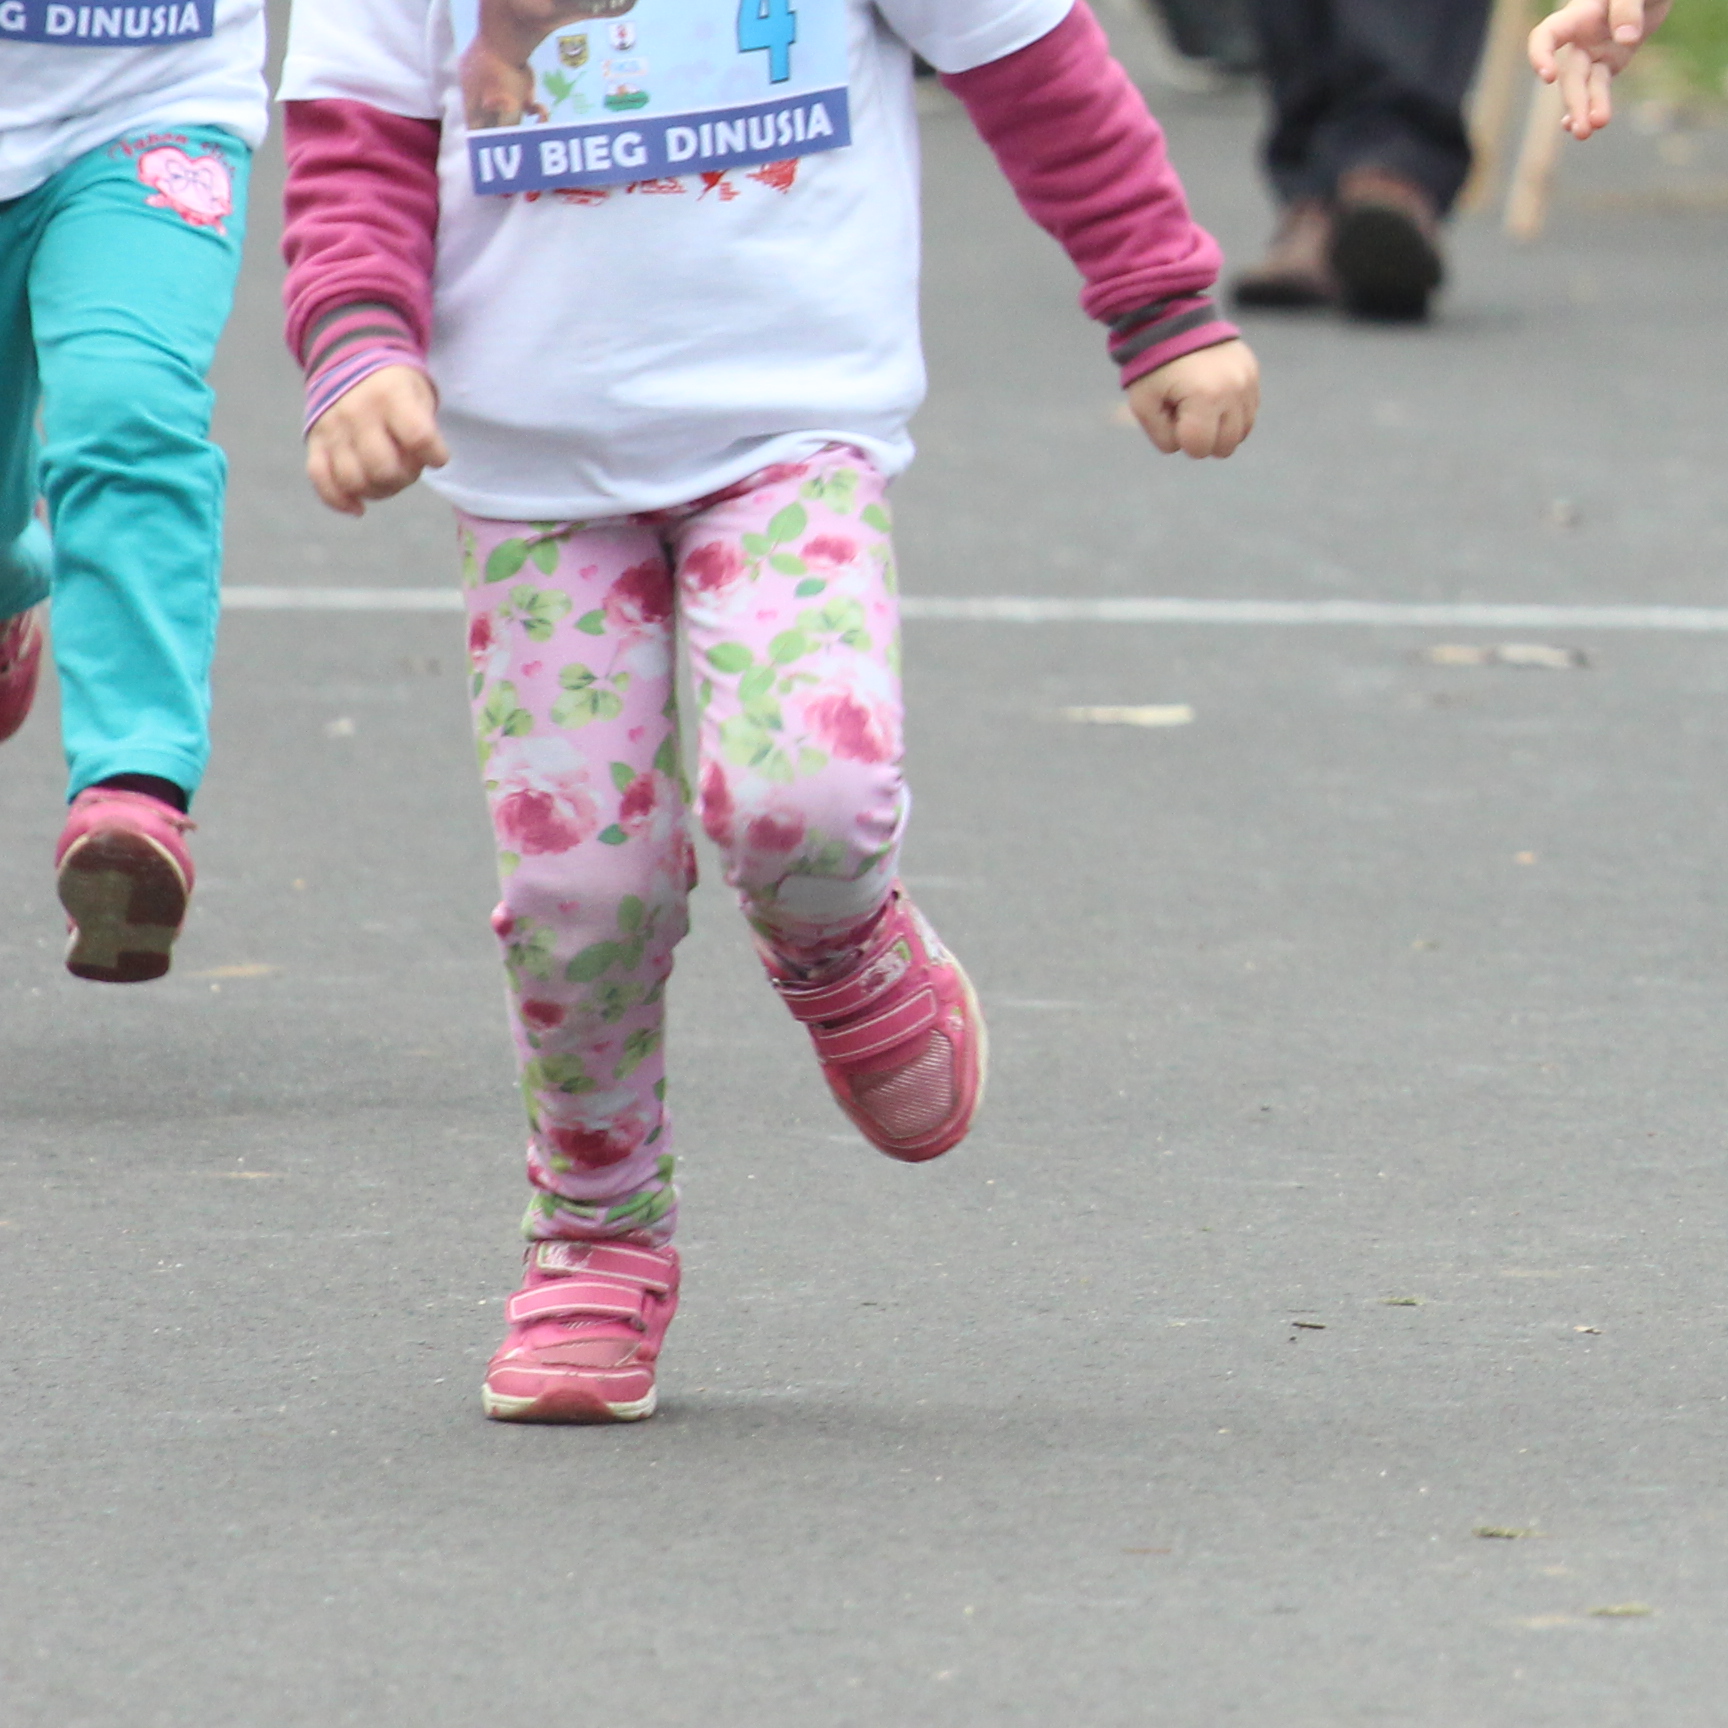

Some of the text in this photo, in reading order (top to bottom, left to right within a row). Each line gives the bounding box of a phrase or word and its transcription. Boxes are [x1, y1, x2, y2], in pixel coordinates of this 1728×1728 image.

[46, 6, 202, 38] DINUSIA
[477, 101, 835, 183] IV BIEG DINUSIA
